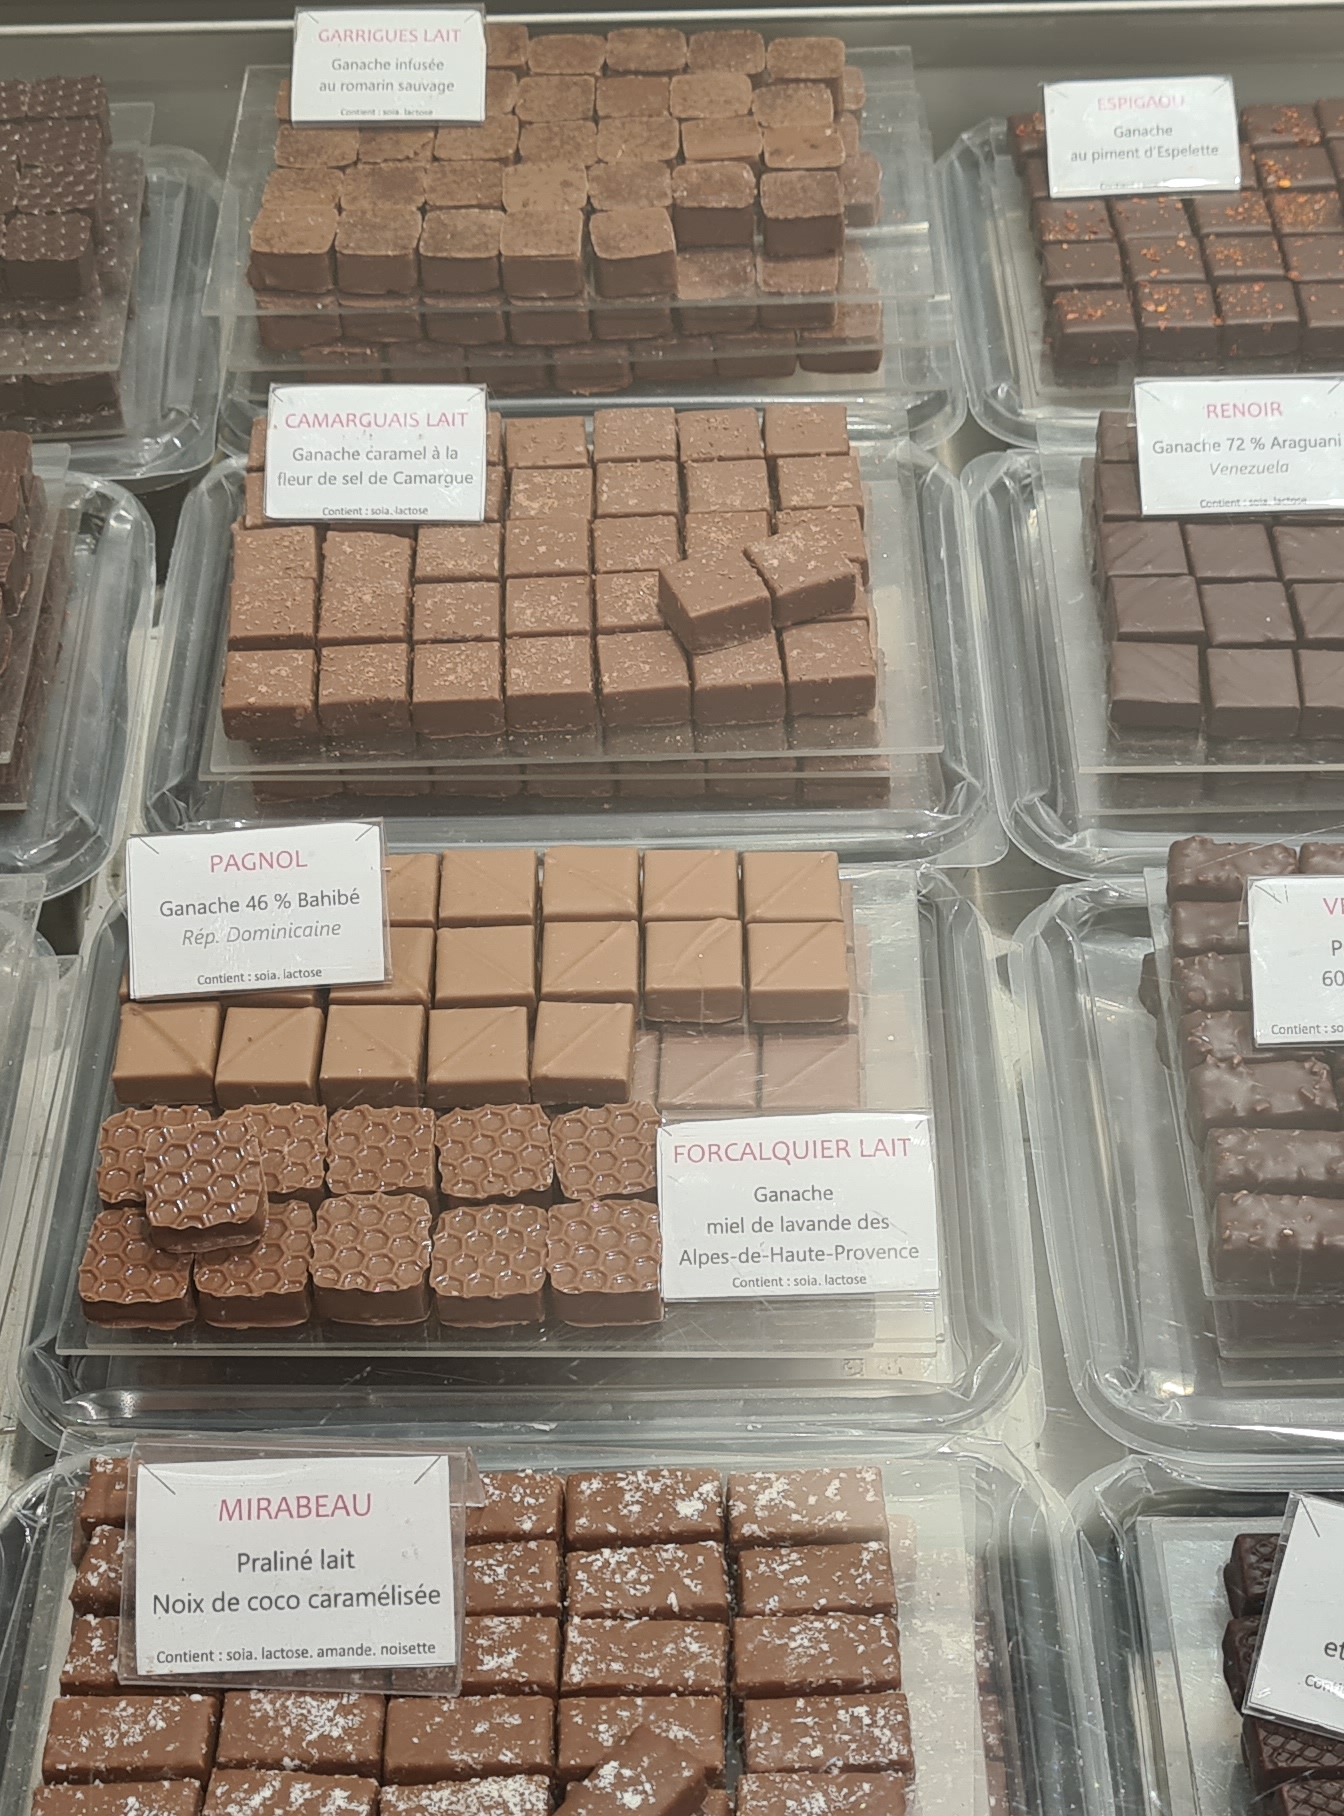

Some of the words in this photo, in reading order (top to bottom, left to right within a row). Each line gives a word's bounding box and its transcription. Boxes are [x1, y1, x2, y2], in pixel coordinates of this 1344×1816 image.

[318, 29, 418, 42] GARRIGUES
[424, 29, 461, 42] LAIT
[332, 59, 391, 70] Ganache
[396, 58, 444, 70] infusée
[319, 82, 335, 92] au
[340, 80, 393, 92] romarin
[398, 81, 454, 94] sauvage
[1114, 126, 1173, 138] Ganache
[1071, 151, 1087, 161] au
[1092, 148, 1139, 163] piment
[1144, 145, 1218, 160] d'Espelette
[1207, 402, 1283, 418] RENOIR
[286, 413, 420, 429] CAMARGUAIS
[427, 412, 468, 427] LAIT
[1153, 439, 1221, 454] Ganache
[1227, 437, 1245, 452] 72
[1250, 437, 1265, 450] %
[1271, 433, 1341, 452] Araguani
[293, 447, 360, 461] Ganache
[366, 447, 426, 460] caramel
[432, 446, 440, 460] à
[446, 446, 458, 460] la
[1210, 460, 1289, 476] Venezuela
[278, 472, 312, 486] fleur
[318, 471, 337, 486] de
[343, 471, 362, 485] sel
[369, 471, 387, 485] de
[394, 471, 473, 488] Camargue
[323, 507, 362, 516] Contient
[395, 506, 428, 515] lactose
[210, 850, 308, 873] PAGNOL
[160, 897, 239, 917] Ganache
[246, 894, 268, 911] 46
[274, 893, 291, 910] %
[298, 889, 360, 907] Bahibé
[182, 930, 219, 948] Rép.
[227, 920, 341, 943] Dominicaine
[197, 973, 245, 985] Contient
[283, 968, 323, 980] lactose
[1271, 1024, 1321, 1035] Contient
[674, 1139, 851, 1165] FORCALQUIER
[860, 1138, 911, 1158] LAIT
[754, 1185, 834, 1202] Ganache
[707, 1217, 744, 1235] miel
[751, 1216, 773, 1233] de
[780, 1214, 851, 1232] lavande
[857, 1213, 890, 1230] des
[679, 1244, 920, 1269] Alpes-de-Haute-Provence
[732, 1276, 783, 1288] Contient
[825, 1274, 867, 1286] lactose
[218, 1493, 372, 1522] MIRABEAU
[237, 1549, 312, 1573] Praliné
[321, 1549, 356, 1569] lait
[153, 1594, 204, 1615] Noix
[212, 1591, 240, 1612] de
[248, 1594, 300, 1611] coco
[308, 1585, 441, 1609] caramélisée
[157, 1650, 214, 1664] Contient
[380, 1641, 436, 1656] noisette
